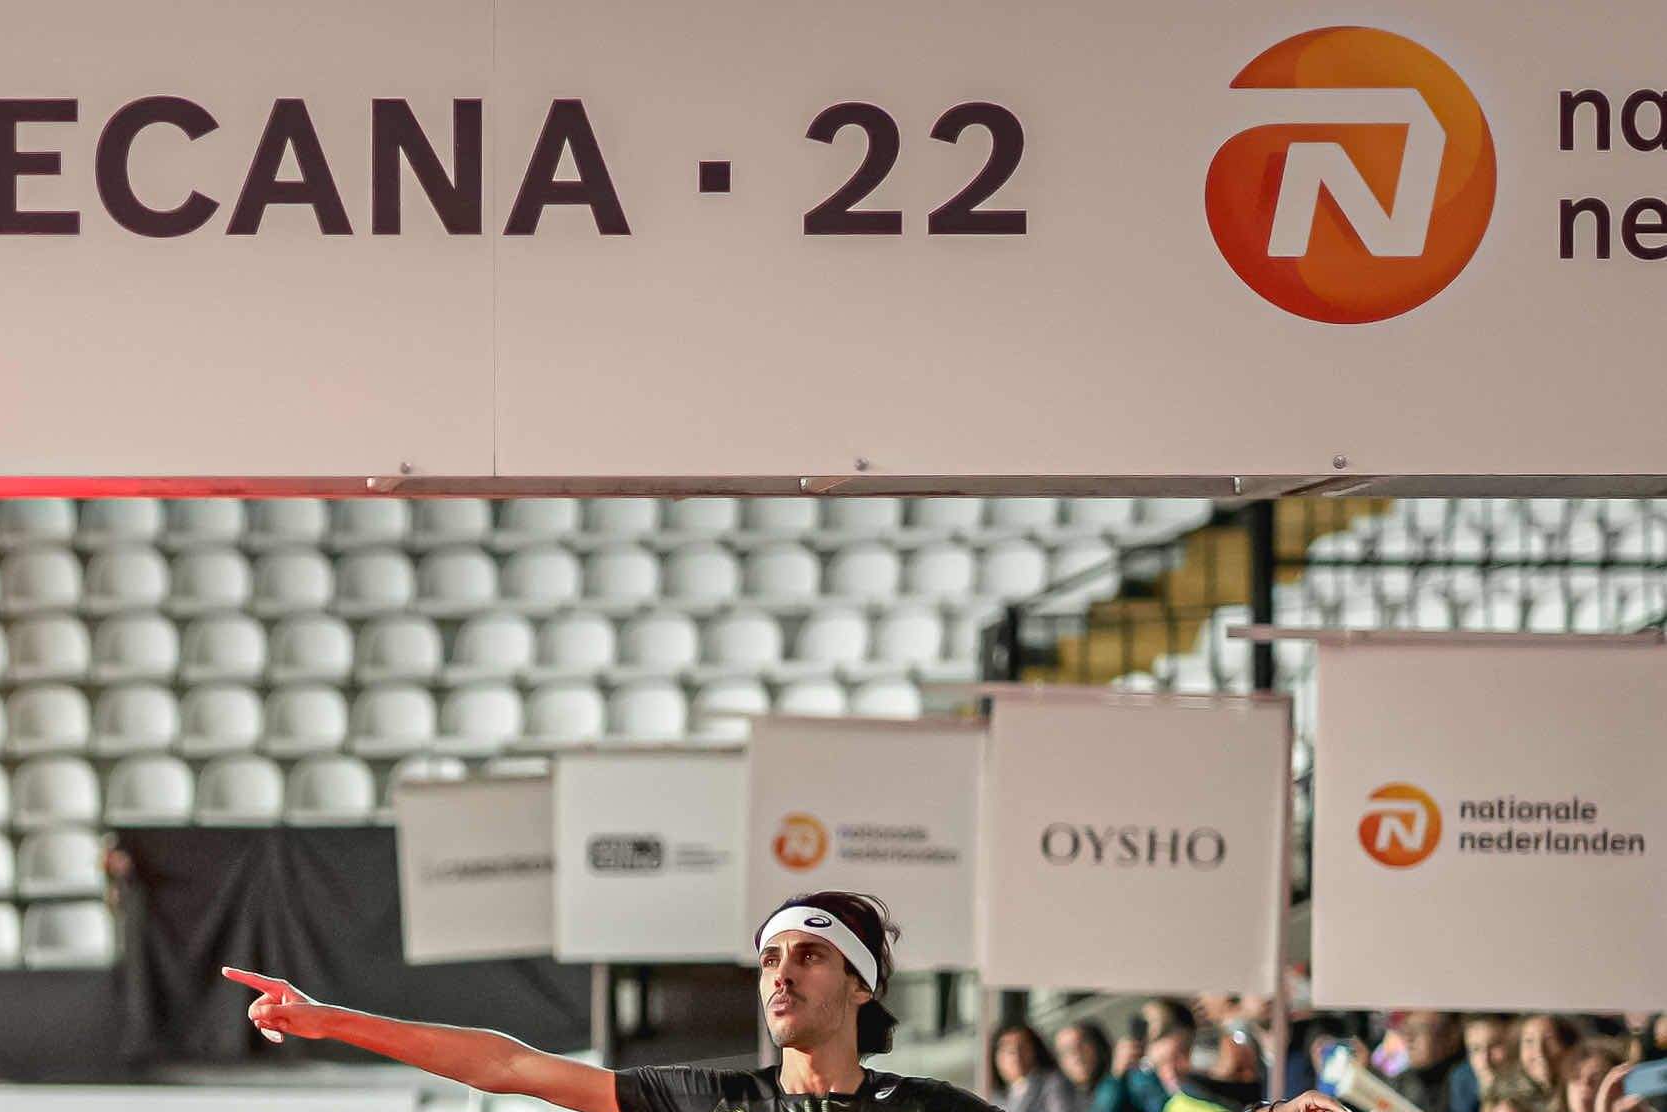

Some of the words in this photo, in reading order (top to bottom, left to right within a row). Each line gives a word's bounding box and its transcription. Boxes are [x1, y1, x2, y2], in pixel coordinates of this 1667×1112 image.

[803, 101, 1028, 236] 22
[1460, 797, 1598, 821] nationale
[1039, 823, 1228, 871] OYSHO
[1459, 826, 1646, 855] nederlanden
